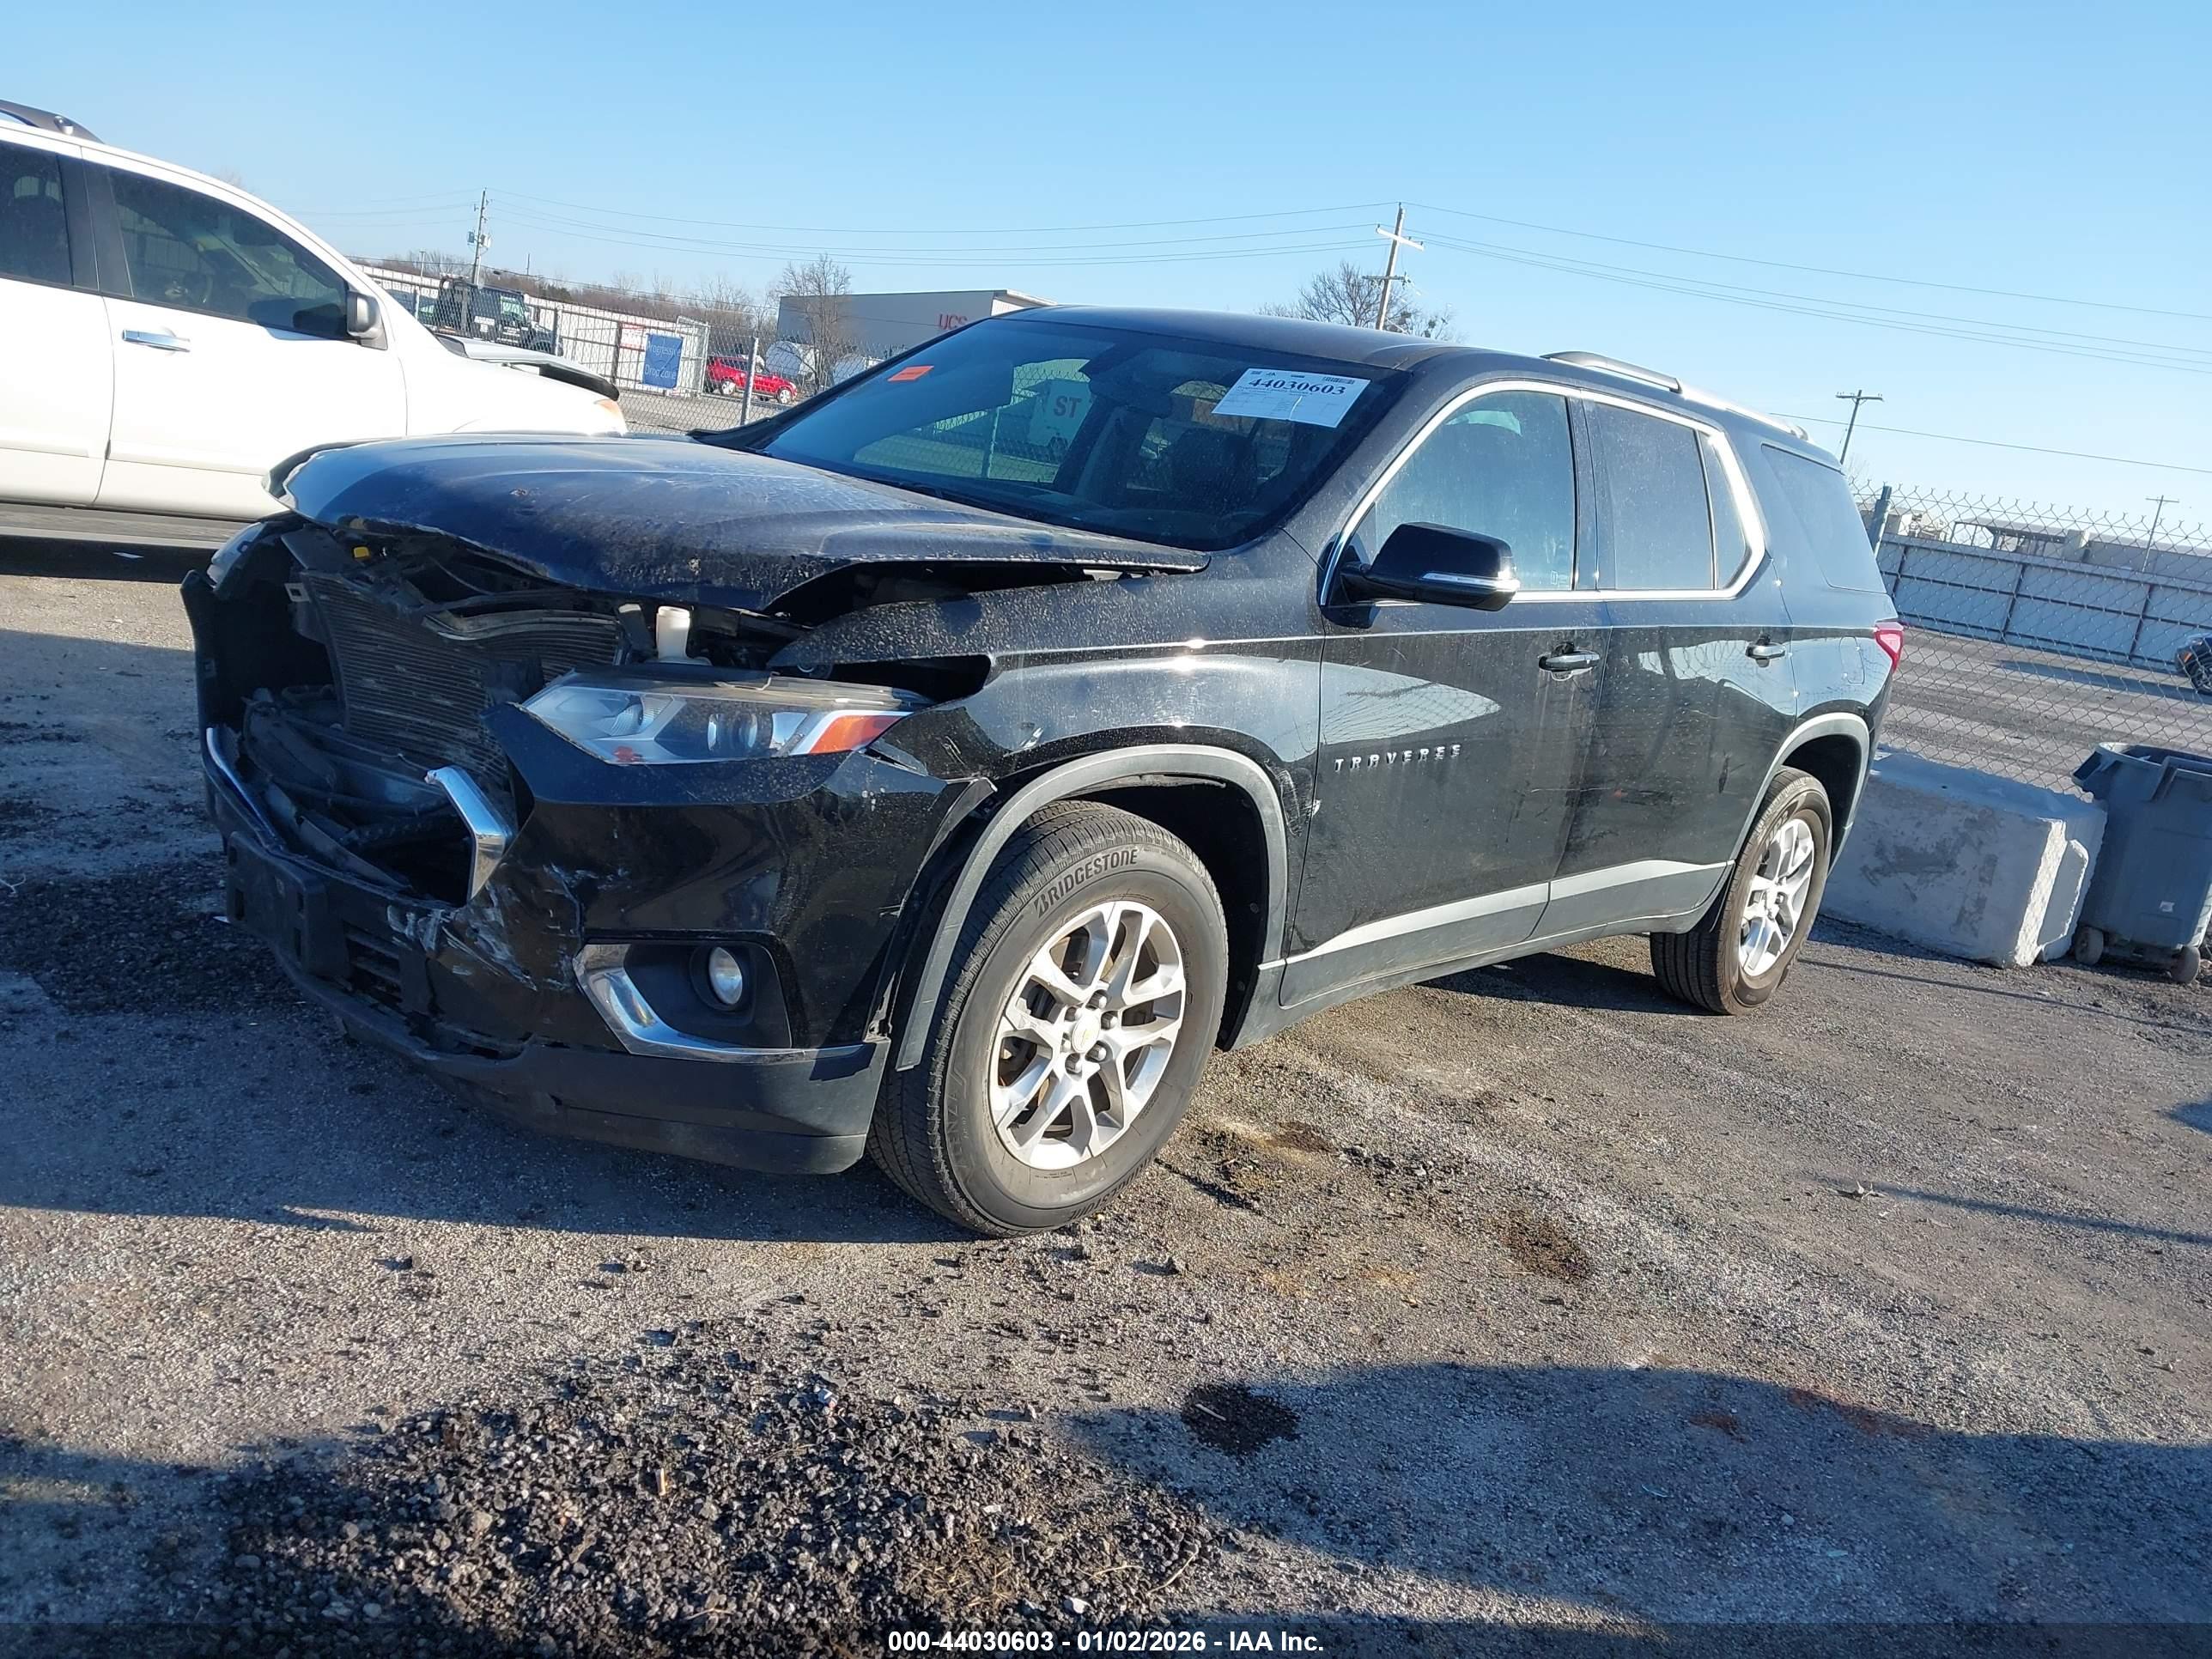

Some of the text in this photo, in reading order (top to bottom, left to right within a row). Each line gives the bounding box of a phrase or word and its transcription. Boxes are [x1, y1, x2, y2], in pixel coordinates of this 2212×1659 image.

[644, 364, 677, 380] Drop Zone
[1249, 377, 1347, 396] 44030603
[1334, 744, 1461, 773] TRAVERSE
[1033, 848, 1138, 919] BRIDGESTONE
